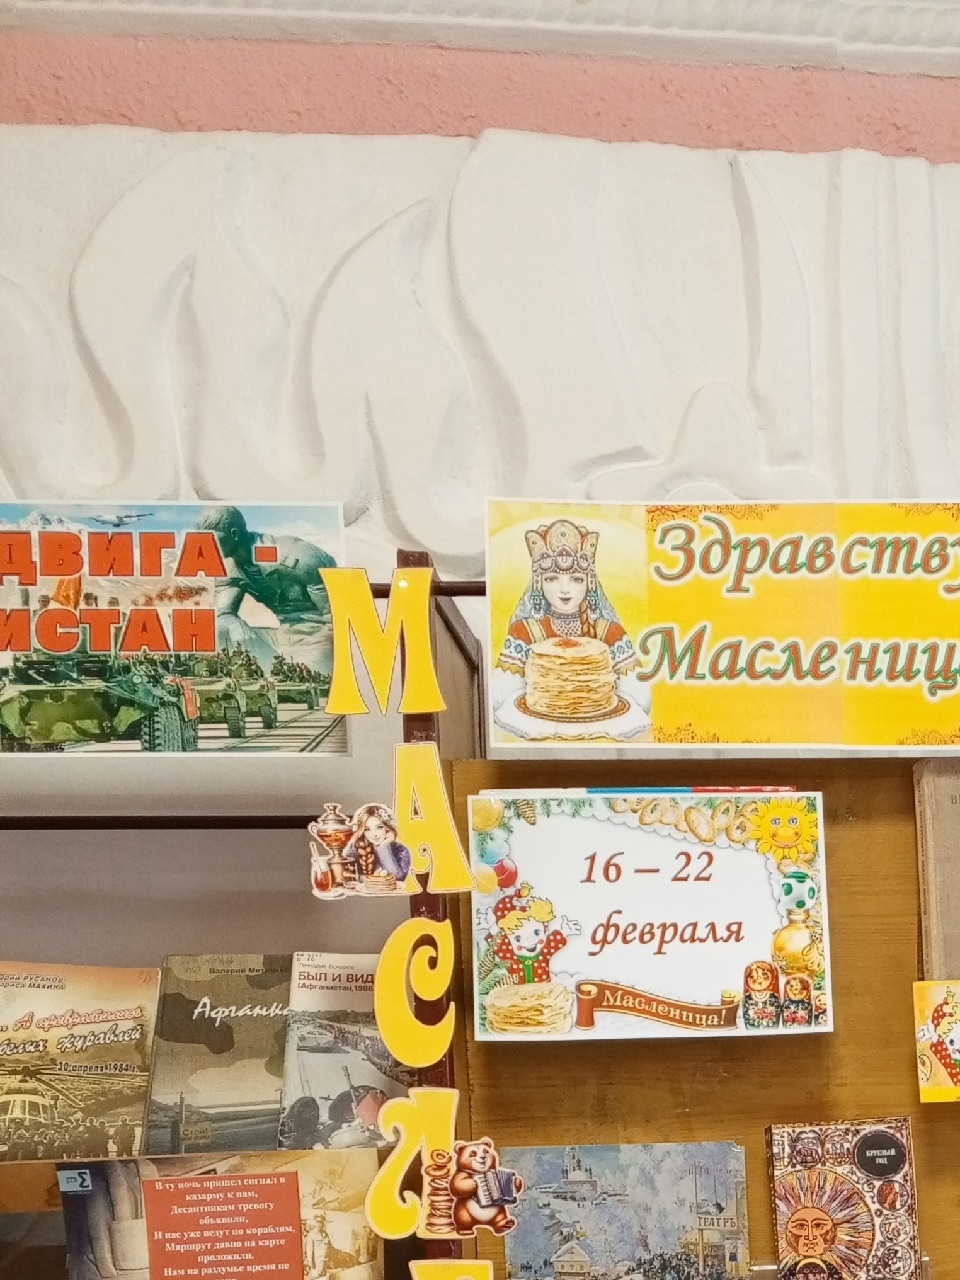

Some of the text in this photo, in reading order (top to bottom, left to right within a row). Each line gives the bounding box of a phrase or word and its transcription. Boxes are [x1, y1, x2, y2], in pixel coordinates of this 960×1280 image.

[580, 851, 715, 884] 16 22
[588, 910, 745, 957] февраля
[299, 971, 327, 982] БЫЛ
[332, 973, 342, 982] И
[601, 987, 727, 1027] Масленица!
